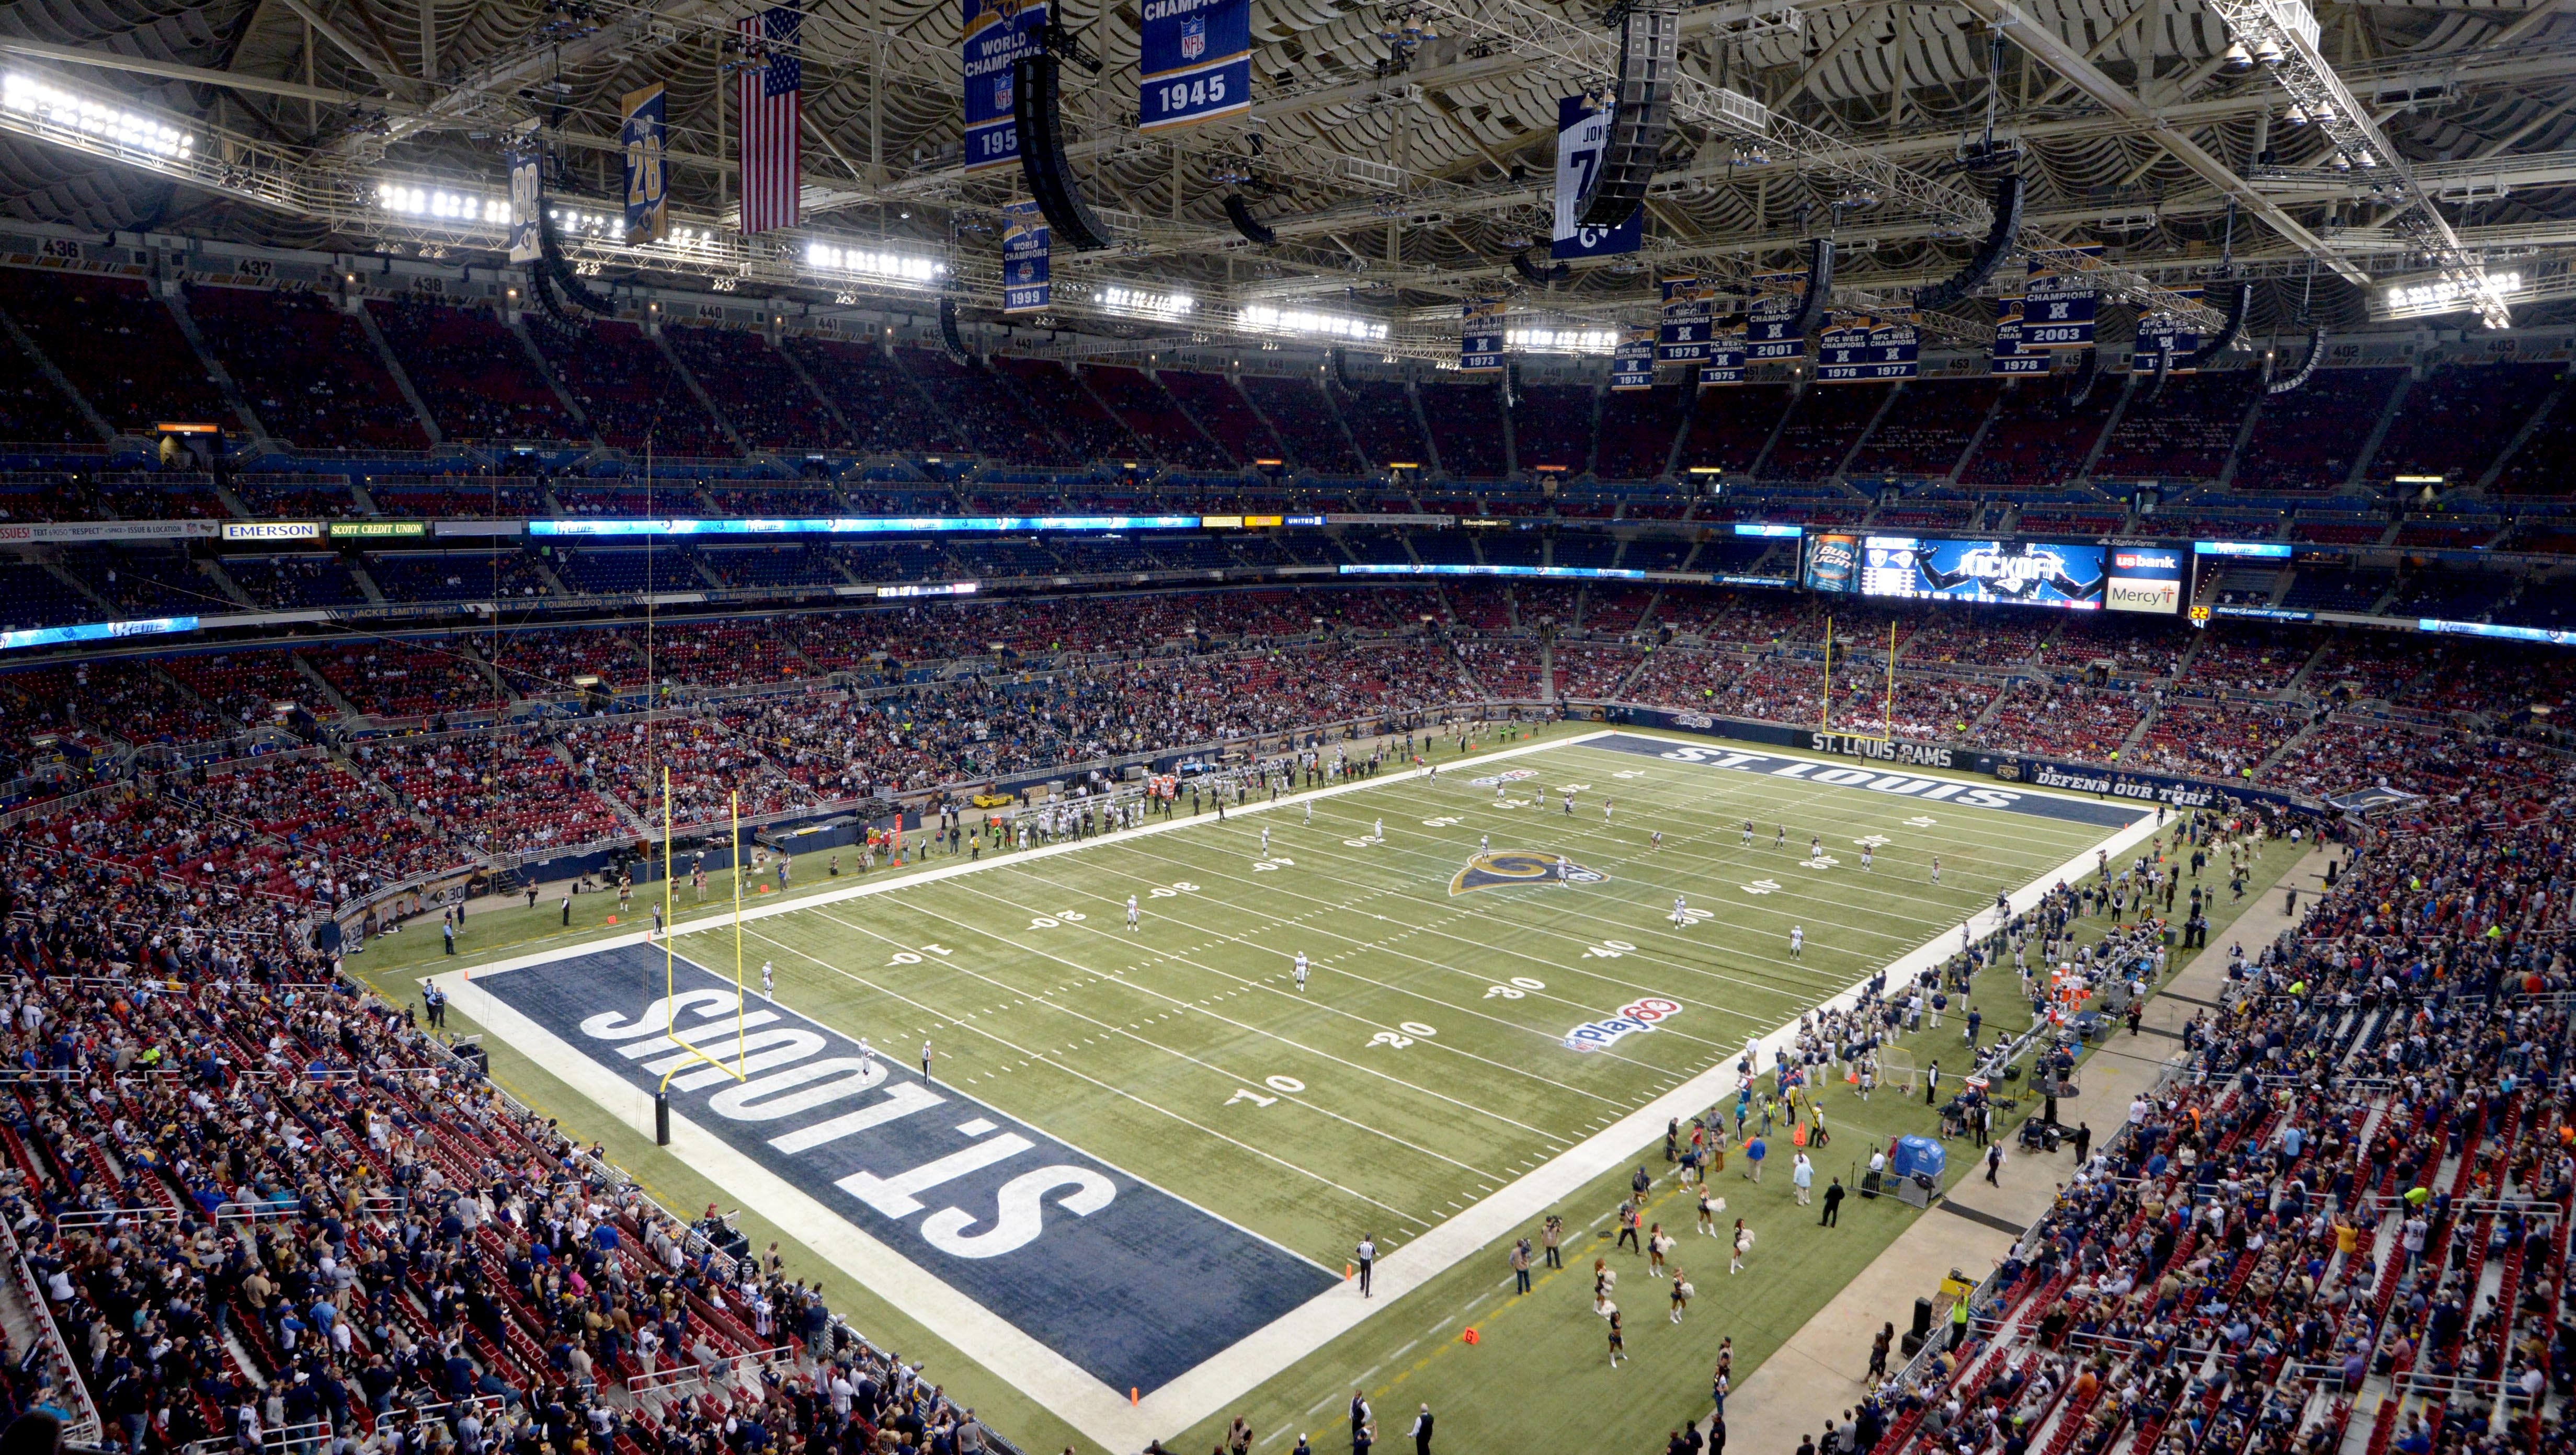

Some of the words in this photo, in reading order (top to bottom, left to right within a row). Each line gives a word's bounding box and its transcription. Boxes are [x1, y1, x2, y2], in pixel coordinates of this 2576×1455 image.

[1145, 0, 1225, 21] CHAMP
[982, 32, 1027, 56] WORLD
[1184, 35, 1203, 55] NFL
[997, 90, 1011, 107] NFL
[1159, 74, 1225, 112] 1945
[1583, 124, 1611, 143] JONE
[981, 129, 1018, 155] 195
[628, 134, 661, 207] 28
[512, 163, 538, 227] 80
[43, 239, 78, 258] 436
[1013, 239, 1039, 251] WORLD
[1005, 247, 1047, 261] CHAMPIONS
[240, 260, 271, 276] 437
[1011, 290, 1040, 305] 1999
[2027, 290, 2094, 302] CHAMPIONS
[1662, 316, 1710, 326] CHAMPIONS
[1464, 329, 1502, 338] CHAMPIONS
[2034, 328, 2080, 341] 2003
[1758, 344, 1792, 356] 2001
[1870, 338, 1917, 347] CHAMPIONS
[1669, 347, 1700, 358] 1979
[2066, 355, 2080, 364] 45
[1469, 356, 1495, 366] 1973
[2004, 360, 2038, 370] 1978
[1709, 372, 1736, 380] 1975
[1828, 368, 1856, 377] 1976
[1877, 366, 1907, 375] 1977
[1620, 376, 1644, 384] 1974
[230, 525, 313, 536] EMERSON
[332, 525, 359, 534] SCOTT
[361, 524, 393, 534] CREDIT
[395, 524, 422, 533] UNION
[1819, 545, 1852, 560] BUD
[1814, 554, 1852, 569] LIGHT
[1960, 555, 2063, 580] KICKOFF
[2112, 587, 2161, 605] Mercy
[542, 600, 602, 609] YOUNGBLOOD
[2191, 606, 2209, 618] 22
[351, 608, 389, 618] JACKIE
[391, 607, 423, 616] SMITH
[1812, 732, 1838, 752] ST.
[1843, 736, 1895, 760] LOUIS
[1900, 743, 1952, 767] RAMS
[1660, 746, 1769, 771] ST.
[1771, 763, 2022, 808] LOUIS
[2036, 772, 2110, 793] DEFEND
[2114, 784, 2154, 799] OUR
[2158, 788, 2212, 807] TURF
[450, 885, 463, 901] 30
[1152, 882, 1200, 897] 30
[1032, 910, 1087, 928] 20
[351, 924, 362, 940] 32
[892, 943, 953, 964] 10
[1588, 940, 1637, 958] 40
[1488, 977, 1546, 999] 30
[1373, 1022, 1438, 1049] 20
[579, 989, 947, 1155] LOUIS
[1235, 1075, 1306, 1107] 10
[834, 1117, 1117, 1259] ST.
[1466, 1330, 1474, 1342] G
